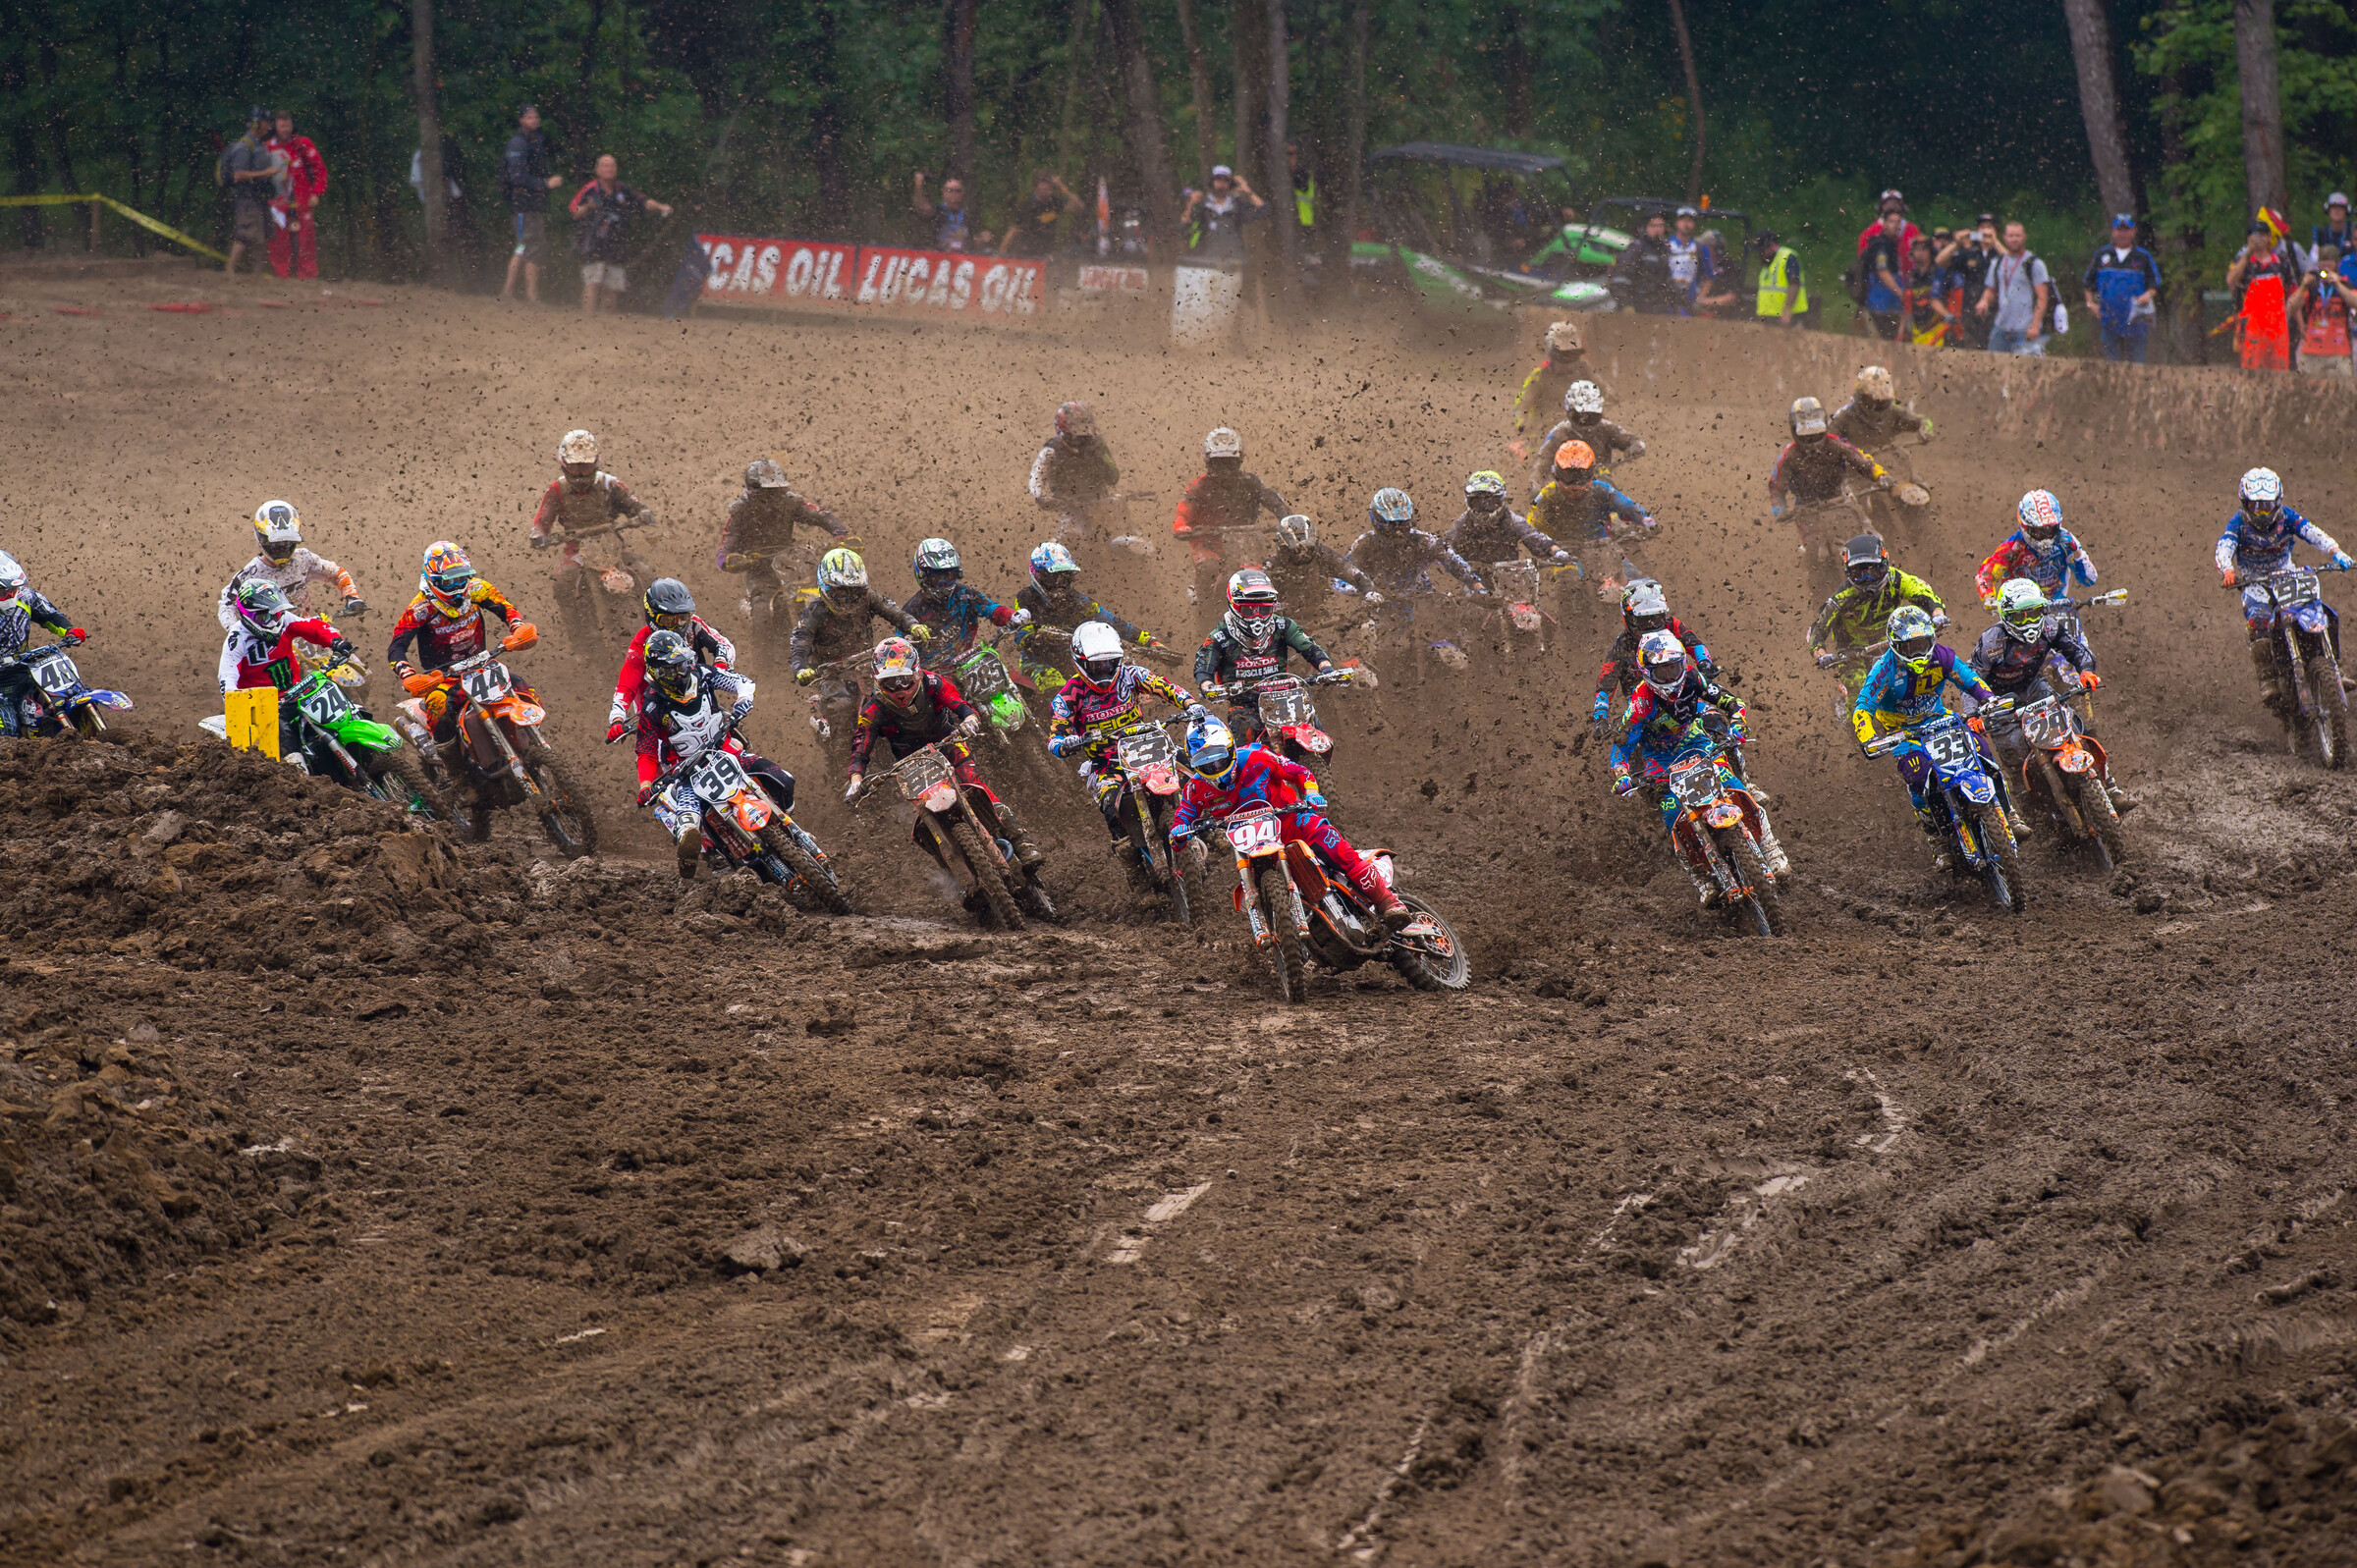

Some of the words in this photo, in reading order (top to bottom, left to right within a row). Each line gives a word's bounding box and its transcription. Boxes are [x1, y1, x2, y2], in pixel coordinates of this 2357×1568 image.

[701, 243, 782, 295] CAS
[787, 246, 844, 297] OIL
[857, 254, 975, 310] LUCAS
[981, 263, 1037, 314] OIL
[2277, 577, 2318, 606] 92
[41, 660, 80, 690] 48
[1234, 656, 1278, 669] HONDA
[471, 665, 507, 701] 44
[310, 687, 349, 725] 24
[1085, 709, 1140, 734] GEICO
[1086, 702, 1134, 723] HONDA
[1129, 737, 1166, 768] 3
[1934, 732, 1970, 766] 33
[699, 757, 738, 801] 39
[1233, 820, 1276, 852] 94
